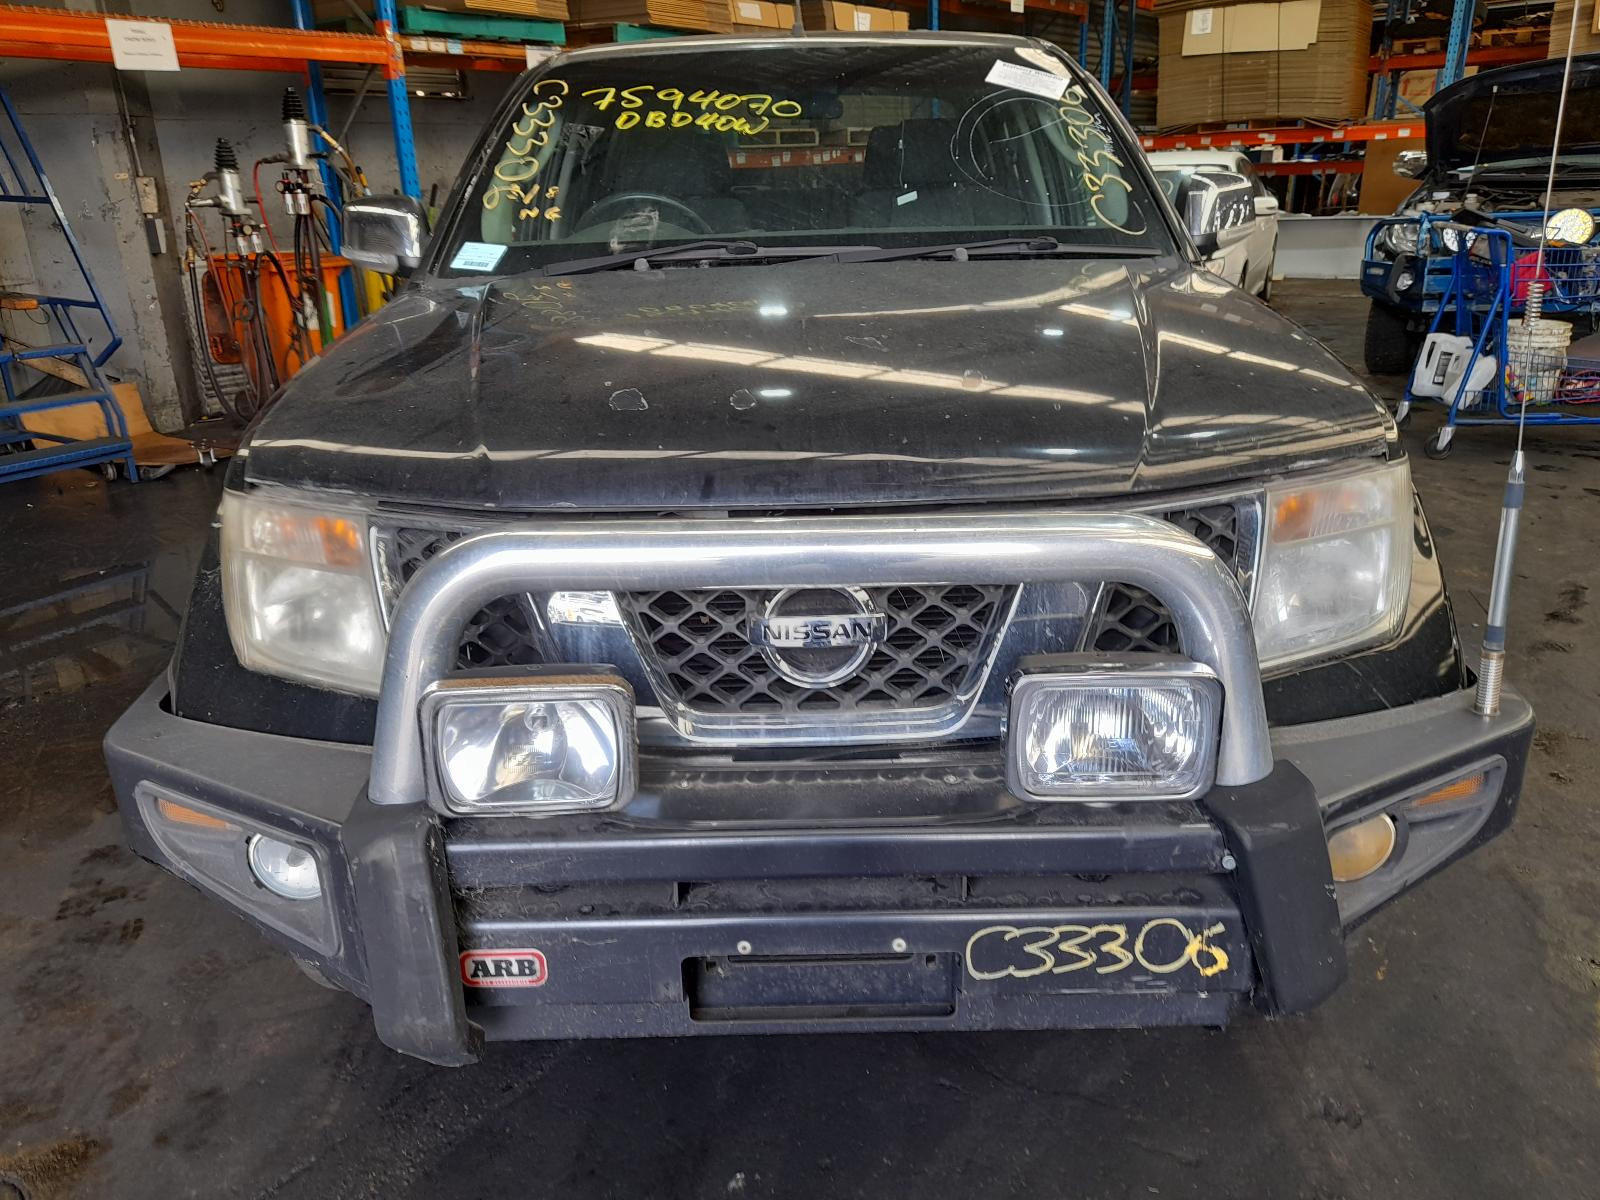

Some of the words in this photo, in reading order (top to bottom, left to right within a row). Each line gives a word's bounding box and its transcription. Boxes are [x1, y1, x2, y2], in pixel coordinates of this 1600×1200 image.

[581, 85, 802, 117] 7594070
[761, 622, 872, 641] NISSAN
[965, 918, 1230, 981] C33306
[470, 959, 537, 979] ARB
